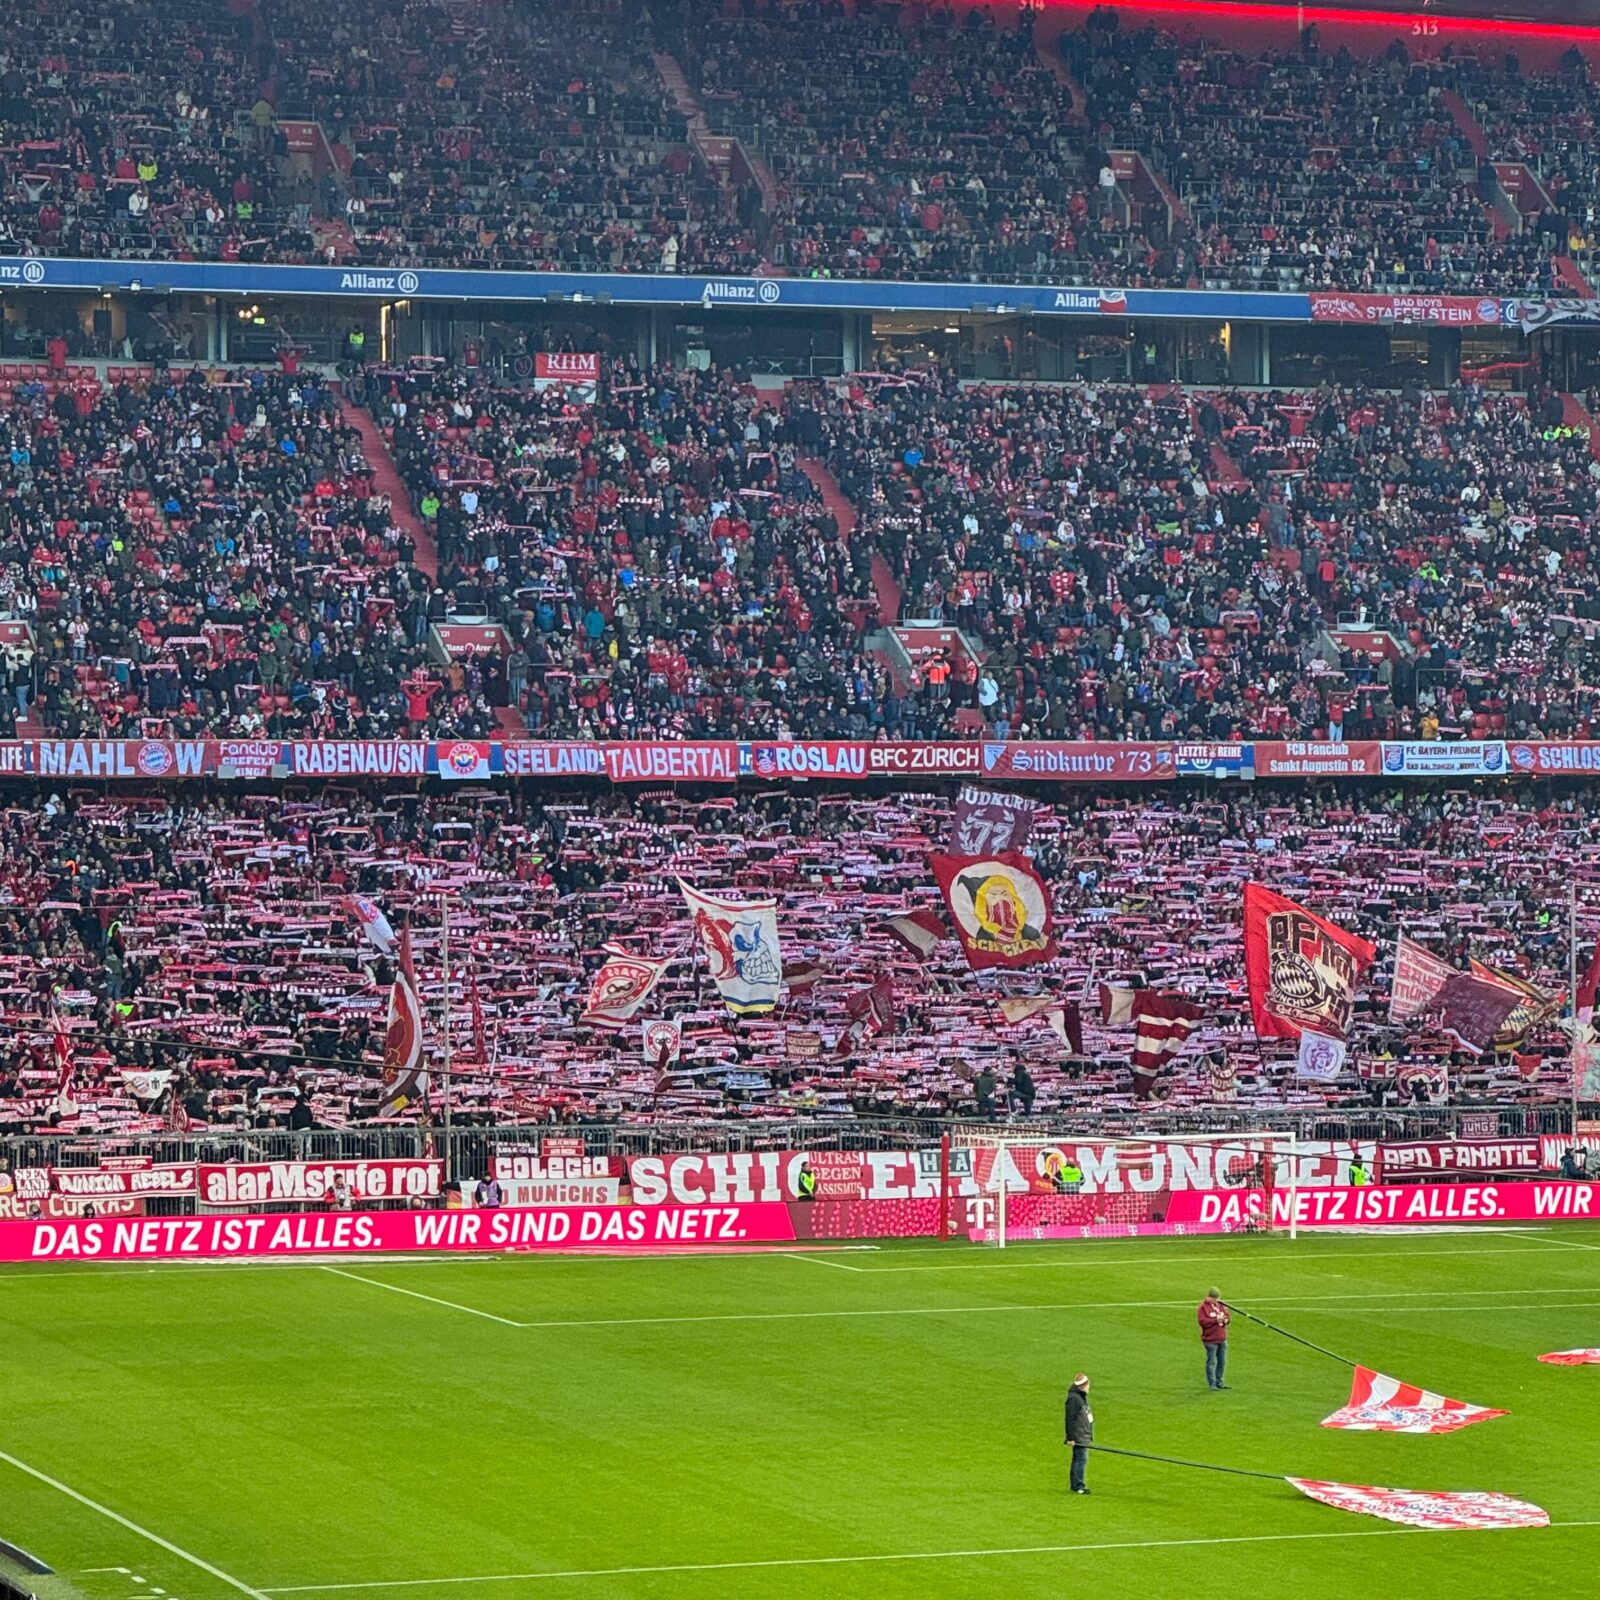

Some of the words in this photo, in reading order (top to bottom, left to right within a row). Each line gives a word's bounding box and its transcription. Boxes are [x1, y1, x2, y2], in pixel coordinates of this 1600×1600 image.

[1412, 20, 1438, 35] 313
[341, 274, 394, 289] Allianz
[703, 283, 755, 298] Allianz
[1393, 298, 1415, 307] BAD
[1417, 299, 1443, 307] BOYS
[547, 354, 596, 370] RHM
[220, 742, 278, 755] Fanclub
[871, 748, 908, 767] BFC
[911, 745, 979, 768] ZÜRICH
[1179, 746, 1208, 757] LETZTE
[1217, 746, 1242, 757] REIHE
[1287, 743, 1305, 755] FCB
[1308, 743, 1348, 755] Fanclub
[1406, 746, 1416, 755] FC
[1418, 745, 1447, 755] BAYERN
[1450, 745, 1481, 755] FREUNDE
[40, 743, 135, 775] MAHL
[174, 743, 205, 775] W
[295, 743, 425, 774] RABENAU/SN
[505, 749, 599, 774] SEELAND
[607, 748, 737, 777] TAUBERTAL
[777, 745, 865, 774] RÖSLAU
[1012, 750, 1116, 772] Südkurve
[1270, 759, 1299, 772] Sankt
[1301, 759, 1347, 773] Augustin
[1358, 1060, 1397, 1079] FCB
[810, 1151, 860, 1164] ULTRAS
[131, 1170, 194, 1191] REBELS
[393, 1163, 441, 1196] rot
[812, 1166, 861, 1181] GEGEN
[16, 1179, 50, 1190] LAND
[814, 1181, 862, 1195] ASSISMUS
[16, 1189, 50, 1199] FRONT
[1534, 1186, 1593, 1215] WIR
[1200, 1193, 1262, 1222] DAS
[1272, 1191, 1349, 1222] NETZ
[1354, 1190, 1403, 1219] IST
[1405, 1187, 1507, 1217] ALLES.
[414, 1213, 482, 1245] WIR
[489, 1211, 571, 1244] SIND
[579, 1210, 646, 1241] DAS
[654, 1208, 747, 1240] NETZ.
[32, 1224, 104, 1257] DAS
[112, 1221, 203, 1254] NETZ
[210, 1218, 267, 1251] IST
[268, 1216, 383, 1249] ALLES.
